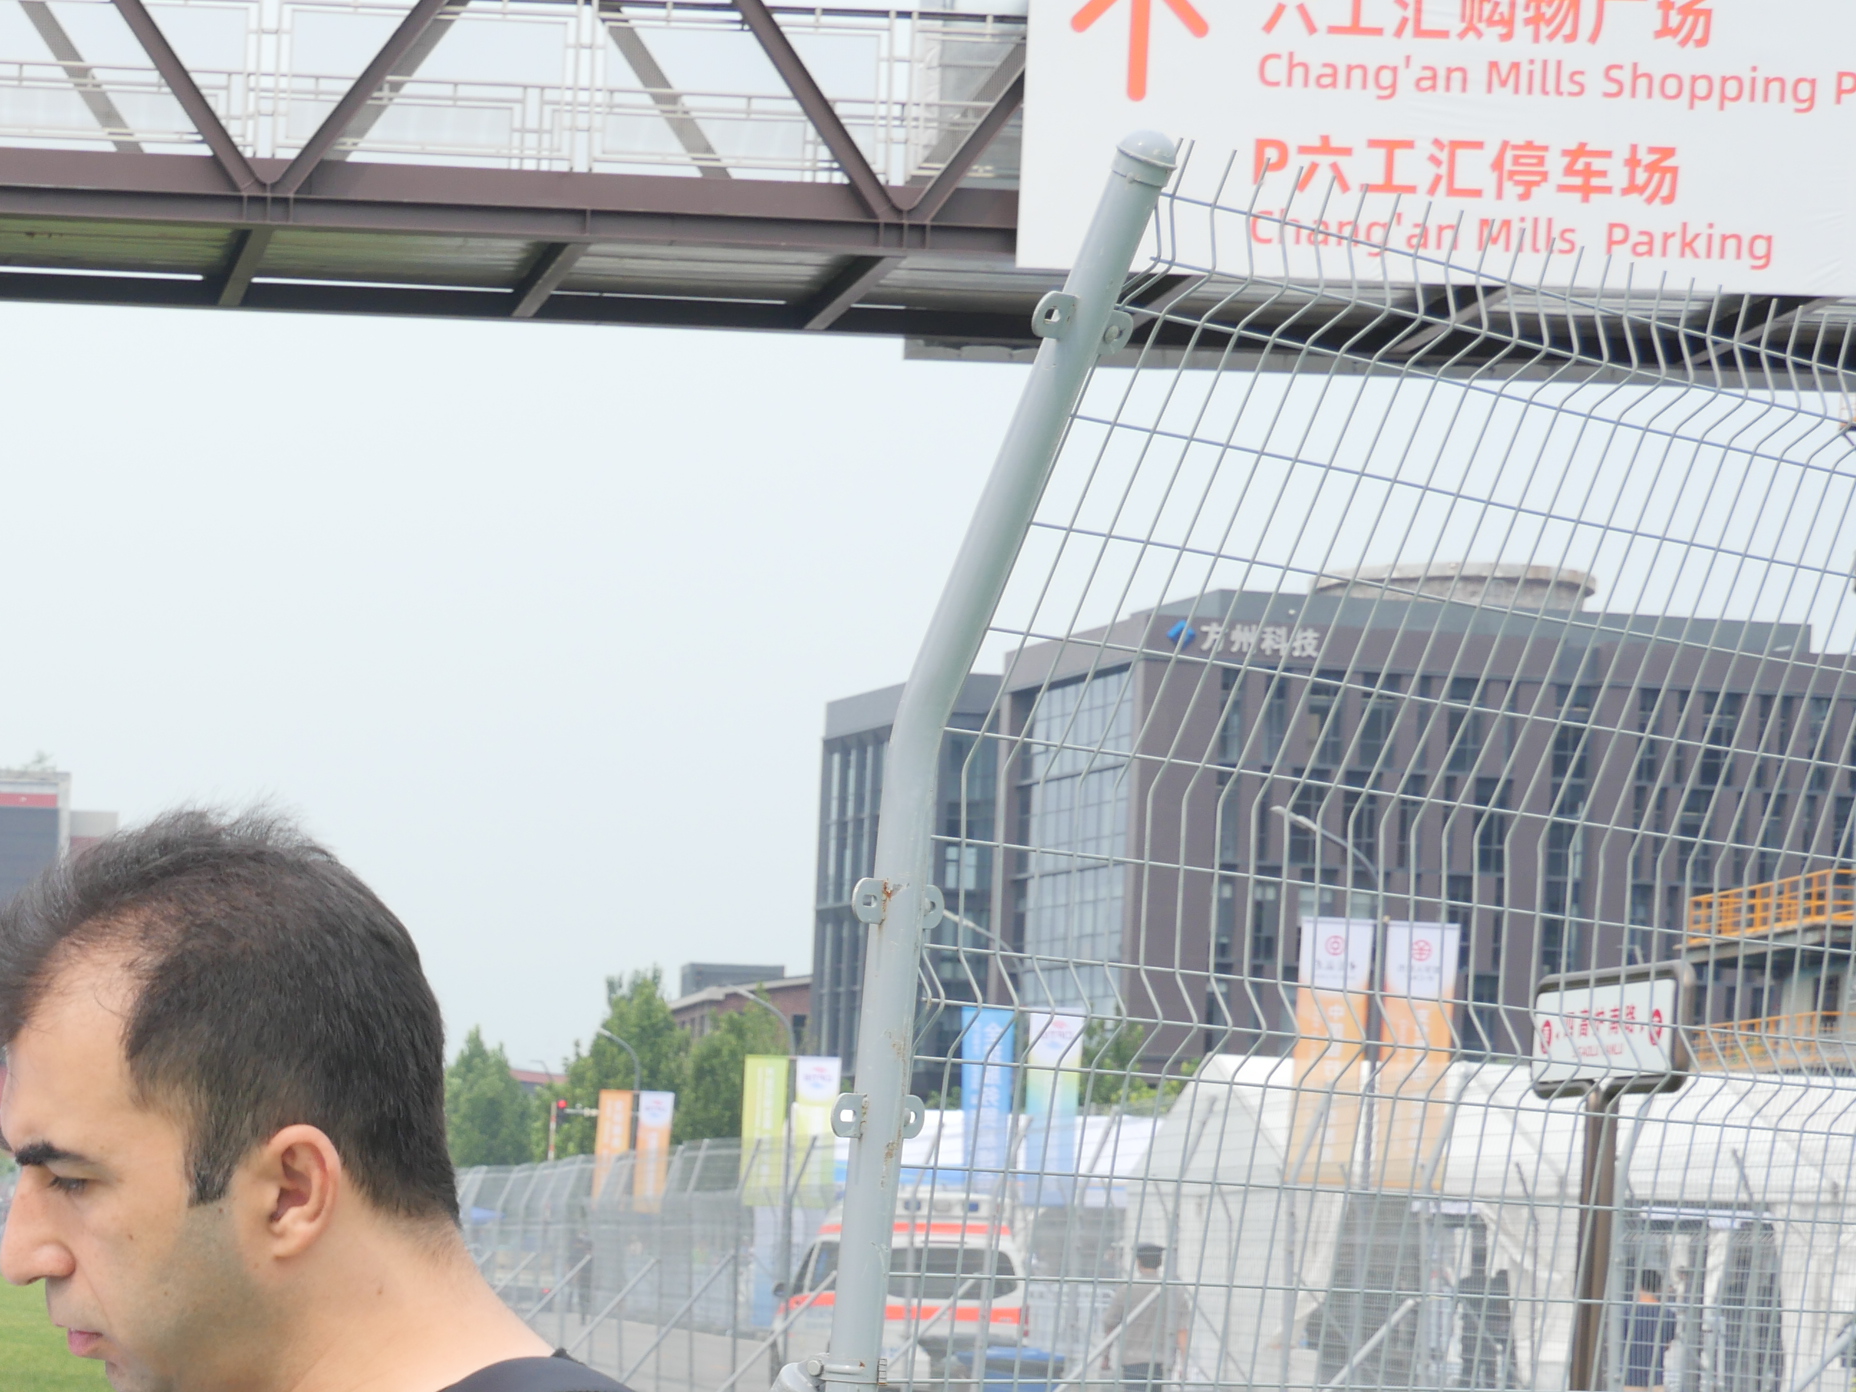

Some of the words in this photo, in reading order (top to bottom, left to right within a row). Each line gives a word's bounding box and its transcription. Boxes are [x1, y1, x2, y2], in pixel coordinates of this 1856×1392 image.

[1262, 0, 1714, 48] 六工汇购物广场
[1257, 50, 1469, 101] Chang'an
[1485, 58, 1587, 97] Mills
[1601, 63, 1818, 114] Shopping
[1251, 134, 1681, 206] P六工汇停车场
[1247, 210, 1461, 258] Chang'an
[1476, 216, 1577, 256] Mills
[1605, 222, 1775, 271] Parking
